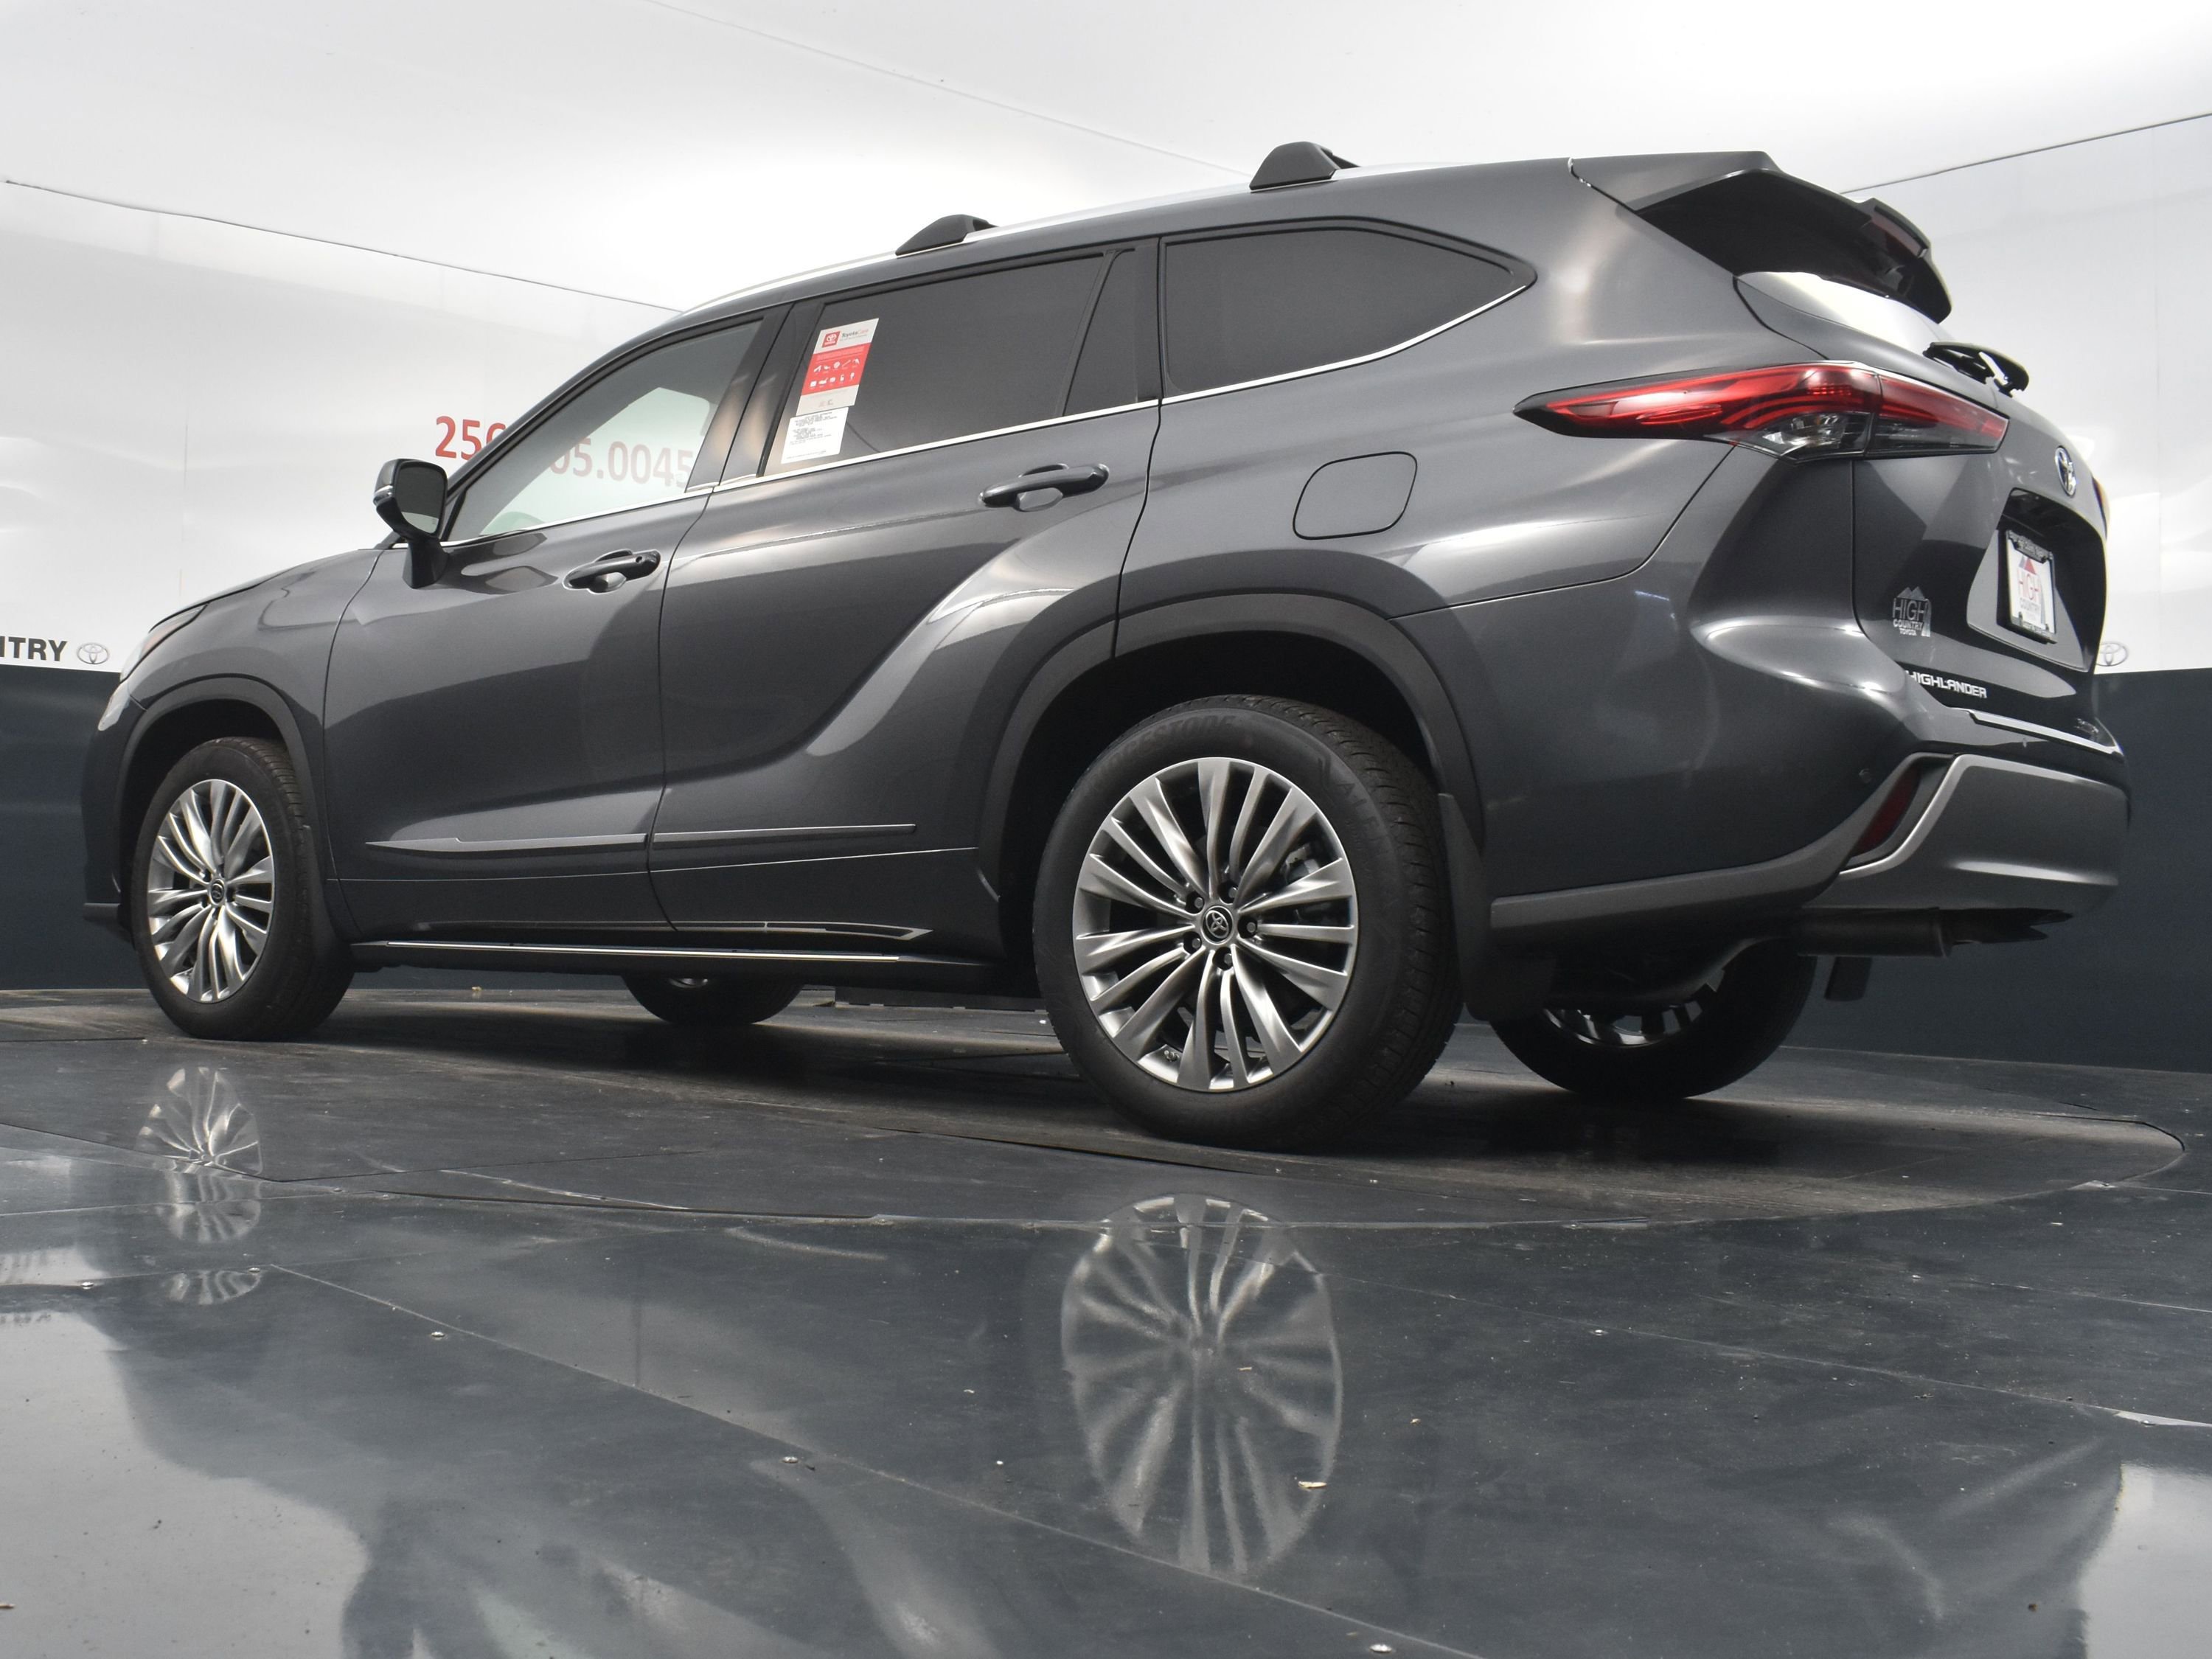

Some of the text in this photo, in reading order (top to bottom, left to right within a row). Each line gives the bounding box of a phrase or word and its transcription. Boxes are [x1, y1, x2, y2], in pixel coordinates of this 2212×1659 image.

[1892, 597, 1927, 621] HIGH
[1893, 618, 1924, 631] COUNTRY
[0, 636, 68, 662] TRY
